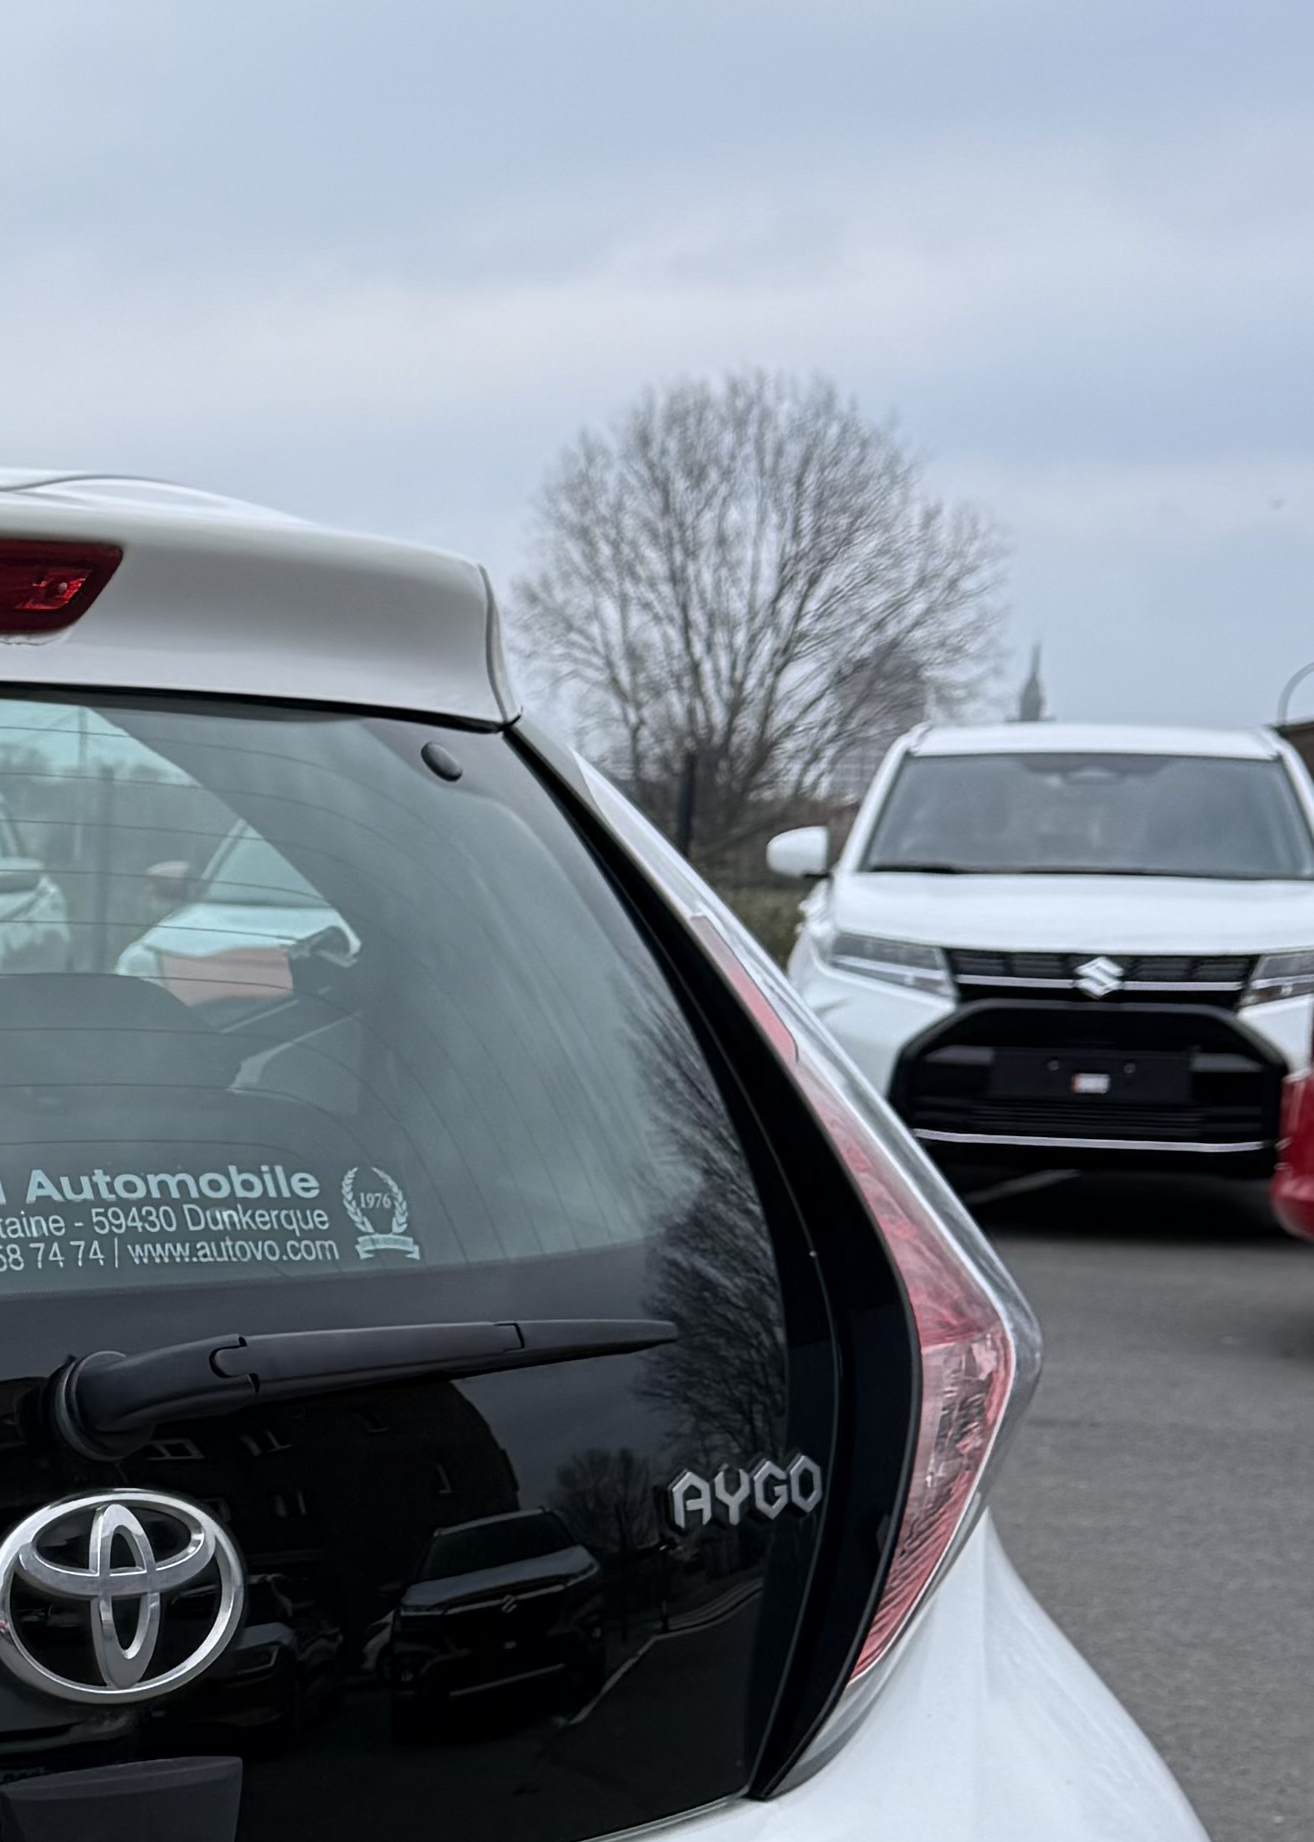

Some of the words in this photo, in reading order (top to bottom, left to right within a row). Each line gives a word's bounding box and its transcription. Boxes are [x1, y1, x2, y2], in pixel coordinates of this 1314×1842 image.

[26, 1165, 320, 1203] Automobile
[360, 1192, 391, 1208] 1976
[92, 1206, 176, 1234] 59430
[183, 1203, 329, 1236] Dunkerque
[31, 1242, 64, 1268] 74
[70, 1240, 104, 1266] 74
[127, 1236, 340, 1265] www.autovo.com
[671, 1455, 823, 1529] AYGO
